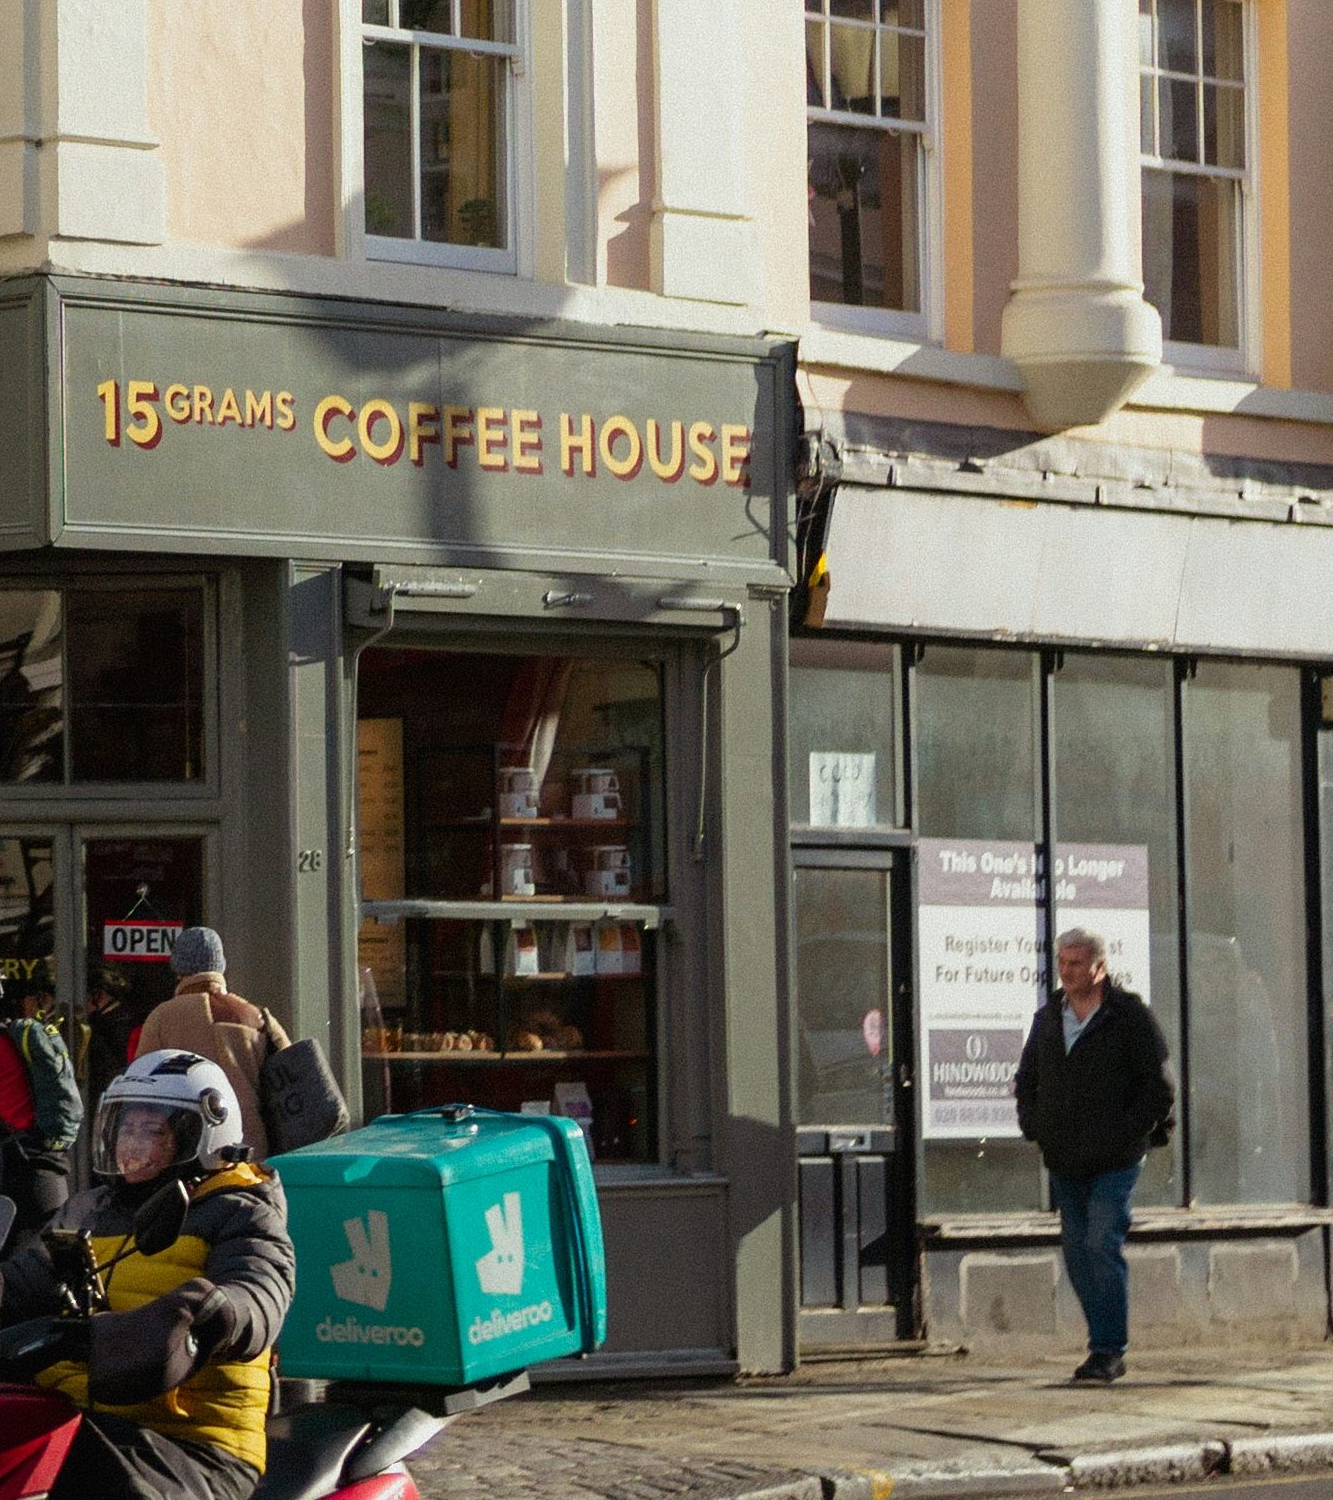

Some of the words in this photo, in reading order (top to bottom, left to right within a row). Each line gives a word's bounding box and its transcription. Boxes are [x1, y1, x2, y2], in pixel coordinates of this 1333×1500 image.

[312, 393, 543, 476] COFFEE
[558, 411, 753, 489] HOUSE
[939, 850, 978, 874] This
[980, 851, 1028, 875] One's
[1068, 854, 1126, 882] Longer
[112, 927, 178, 954] OPEN
[945, 936, 1010, 956] Register
[936, 966, 959, 983] For
[966, 966, 1015, 983] Future
[315, 1315, 426, 1348] deliveroo
[467, 1300, 554, 1346] deliveroo
